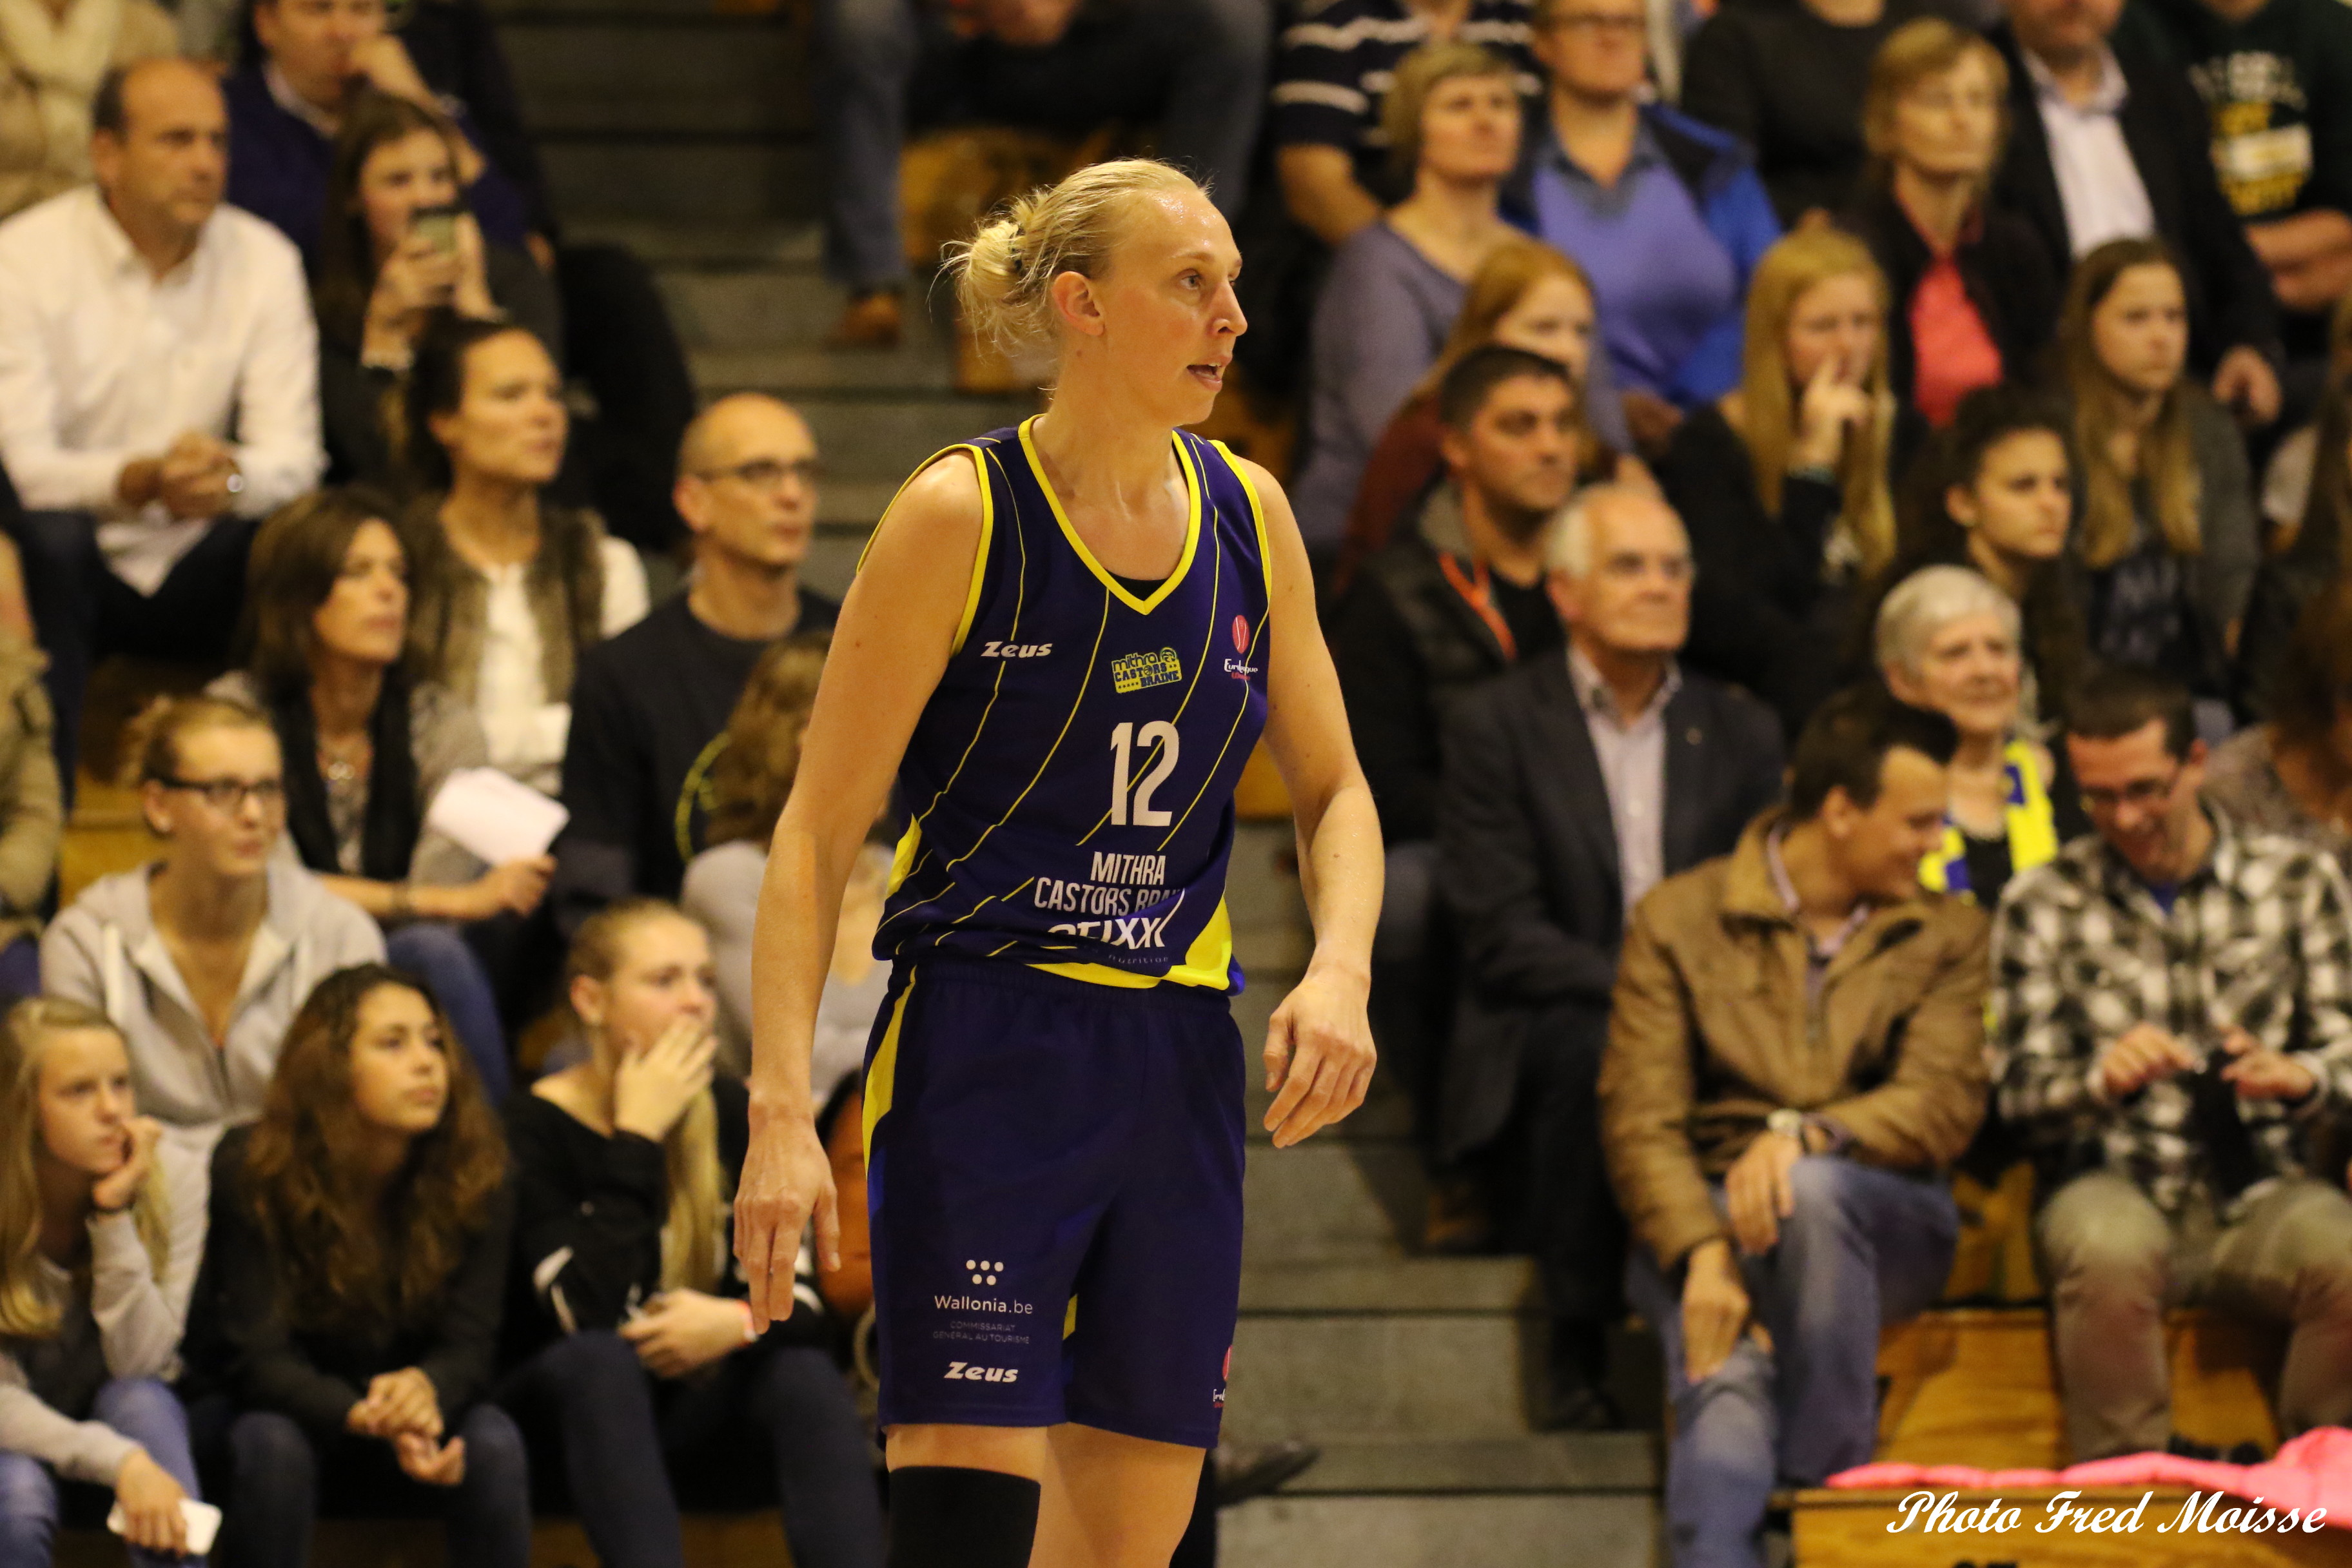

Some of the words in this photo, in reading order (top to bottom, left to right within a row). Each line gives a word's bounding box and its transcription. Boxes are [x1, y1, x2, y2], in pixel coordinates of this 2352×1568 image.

[981, 642, 1053, 658] Zeus
[1115, 662, 1167, 682] CASTORS
[1141, 671, 1179, 687] BRAINE
[1110, 720, 1179, 827] 12
[1090, 851, 1166, 885] MITHRA
[1034, 877, 1132, 916] CASTORS
[934, 1295, 1033, 1314] Wallonia.be
[950, 1321, 1016, 1332] COMMISSARIAT
[975, 1333, 988, 1342] AU
[990, 1334, 1030, 1344] TOURISME
[944, 1361, 1019, 1382] Zeus
